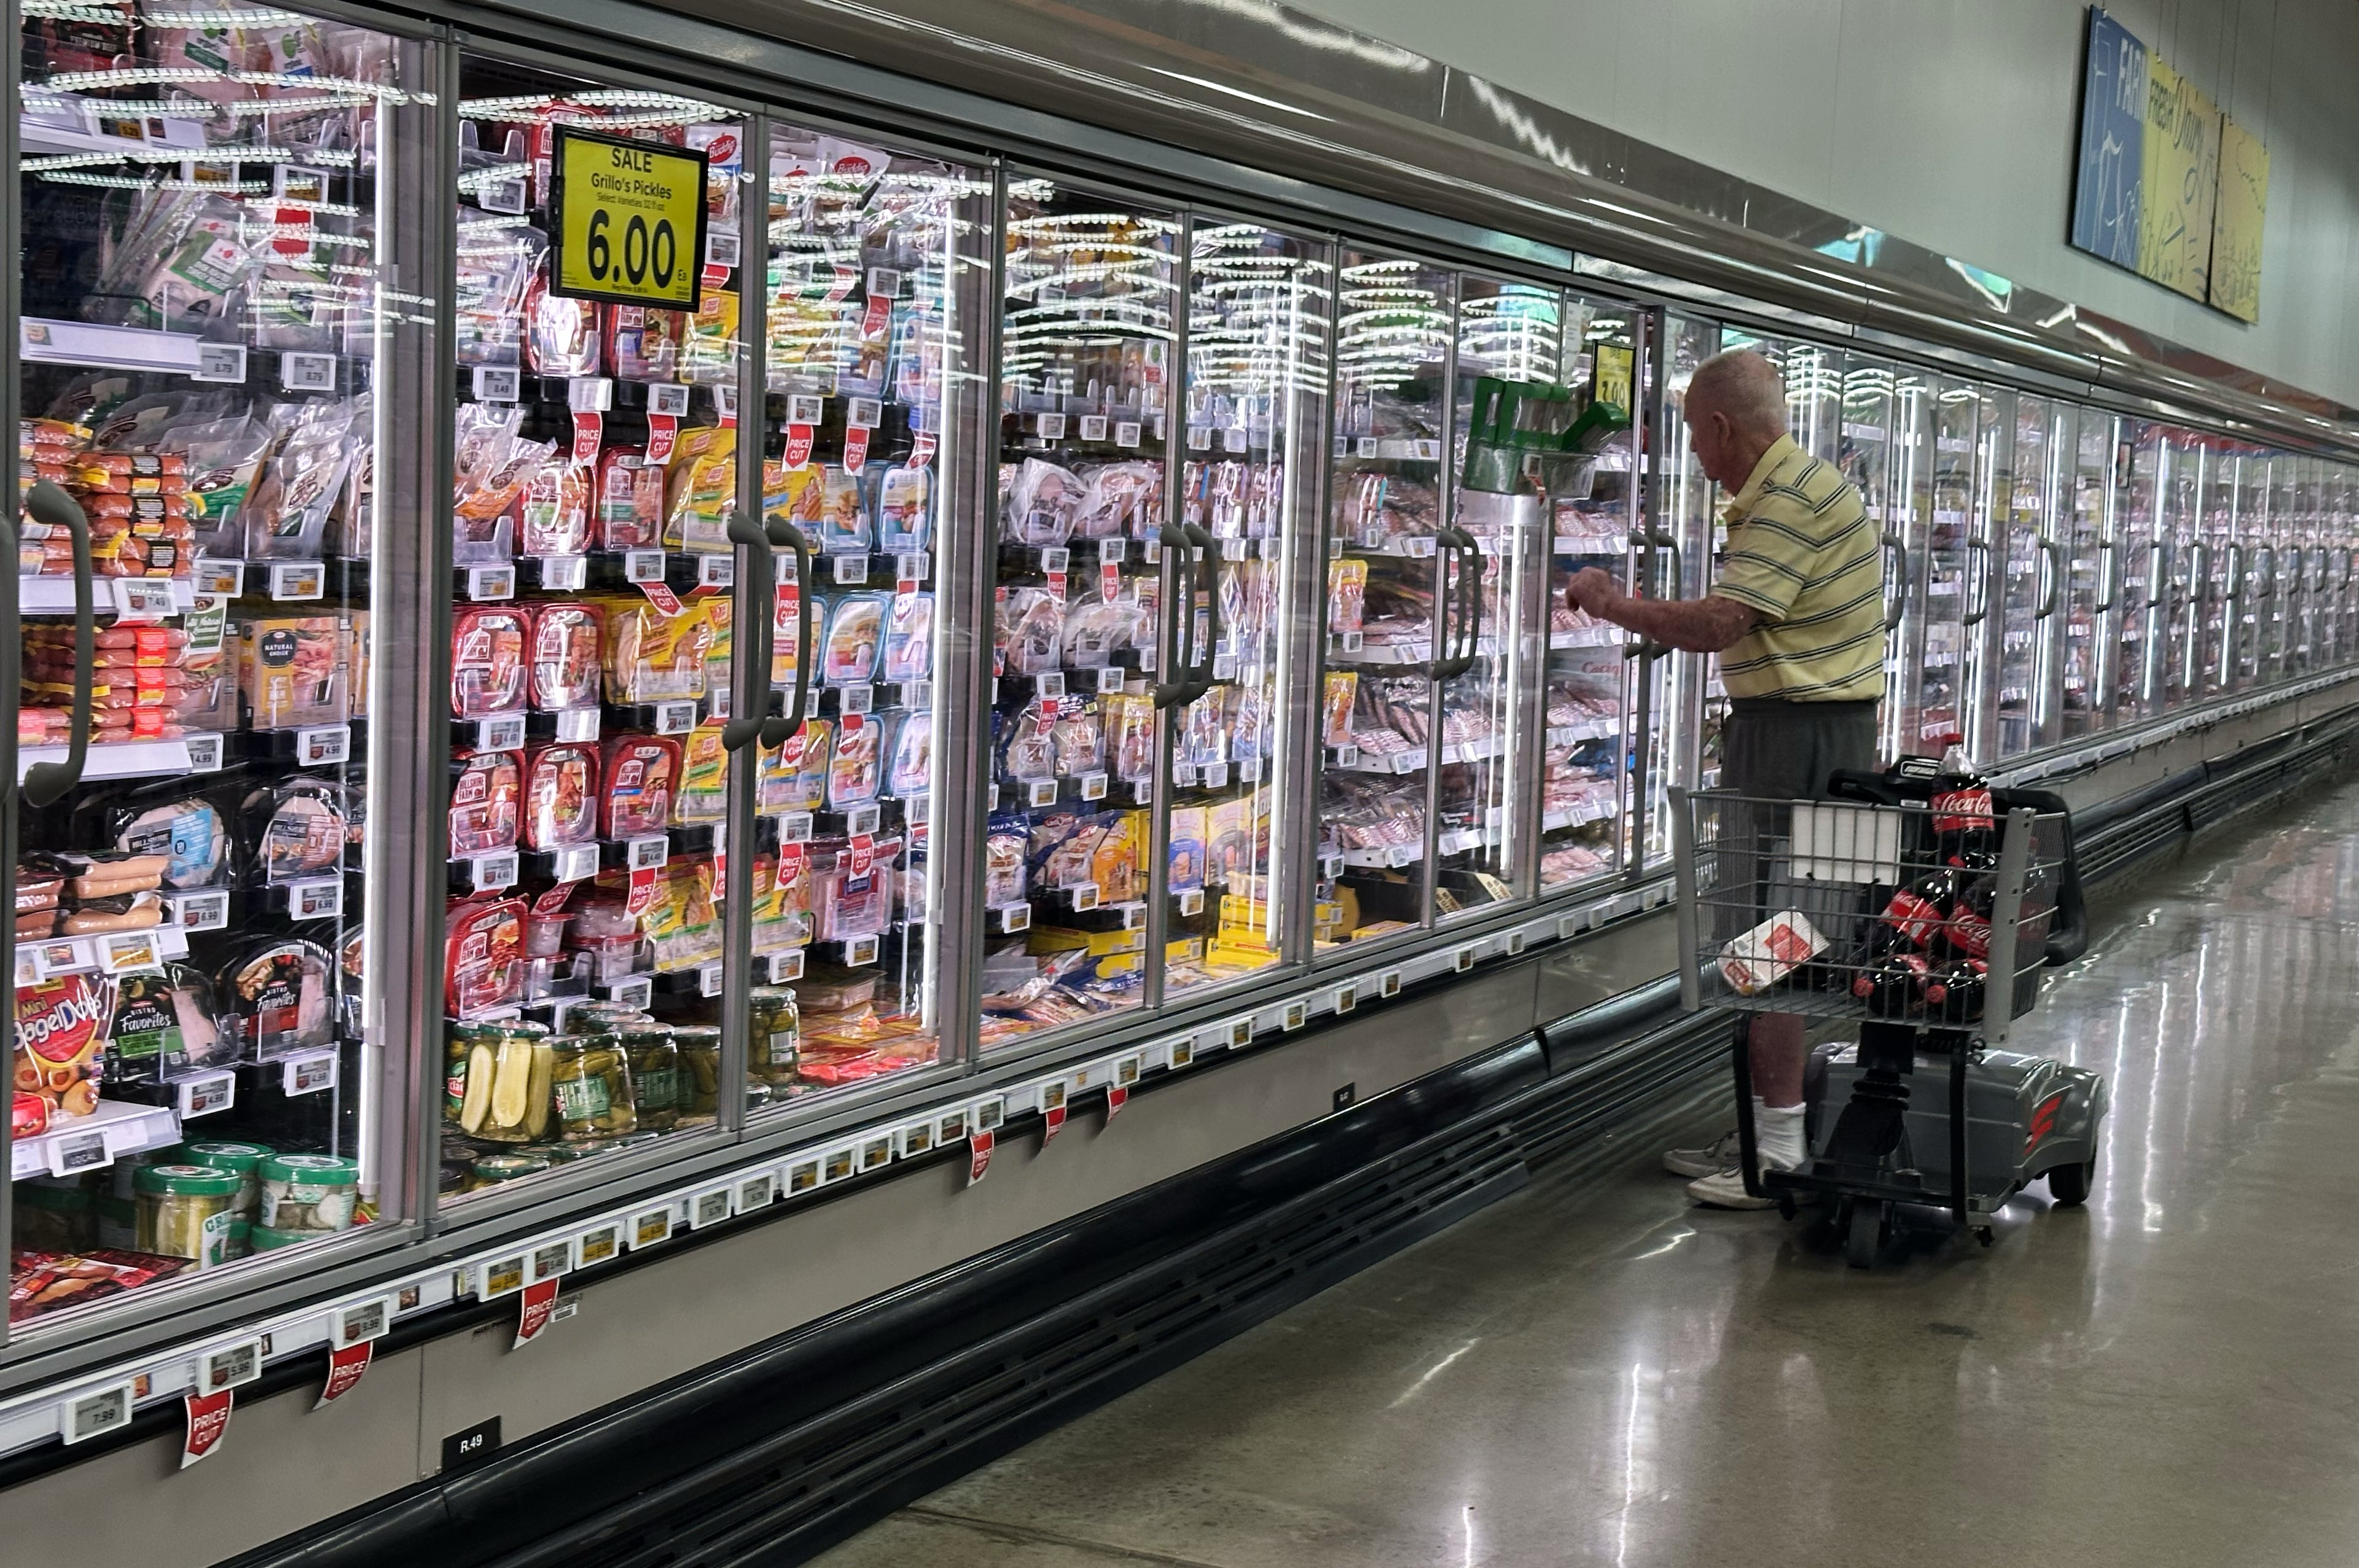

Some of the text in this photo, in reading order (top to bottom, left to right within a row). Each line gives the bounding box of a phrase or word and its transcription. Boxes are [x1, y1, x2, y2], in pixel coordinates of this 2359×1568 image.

[709, 139, 736, 158] Buddig
[611, 147, 652, 173] SALE
[591, 173, 672, 200] Grillo's Pickles
[588, 209, 676, 289] 6.00
[578, 429, 599, 440] PRICE
[652, 429, 674, 440] PRICE
[579, 442, 595, 453] CUT
[654, 442, 670, 452] CUT
[789, 439, 810, 448] PRICE
[847, 443, 866, 453] PRICE
[790, 450, 805, 459] CUT
[848, 454, 861, 463] CUT
[648, 587, 671, 598] PRICE
[657, 597, 673, 607] CUT
[1581, 661, 1622, 677] Caciq
[325, 746, 341, 755] 4.99
[195, 754, 212, 763] 4.99
[460, 776, 484, 790] HILLSHIRE
[459, 789, 473, 798] FARM
[855, 847, 872, 858] PRICE
[782, 857, 800, 867] PRICE
[855, 859, 869, 869] CUT
[782, 868, 796, 878] CUT
[632, 883, 652, 897] PRICE
[317, 899, 333, 910] 6.99
[542, 895, 560, 906] CUT
[632, 894, 646, 907] CUT
[266, 986, 288, 996] BISTRO
[20, 996, 49, 1017] Mini
[257, 991, 297, 1012] Favorites
[130, 1007, 157, 1016] BISTRO
[119, 1013, 172, 1033] Favorites
[526, 1298, 553, 1319] PRICE
[526, 1313, 547, 1330] CUT
[334, 1360, 367, 1379] PRICE
[194, 1406, 228, 1432] PRICE
[195, 1425, 221, 1445] CUT
[460, 1434, 483, 1454] R.49
